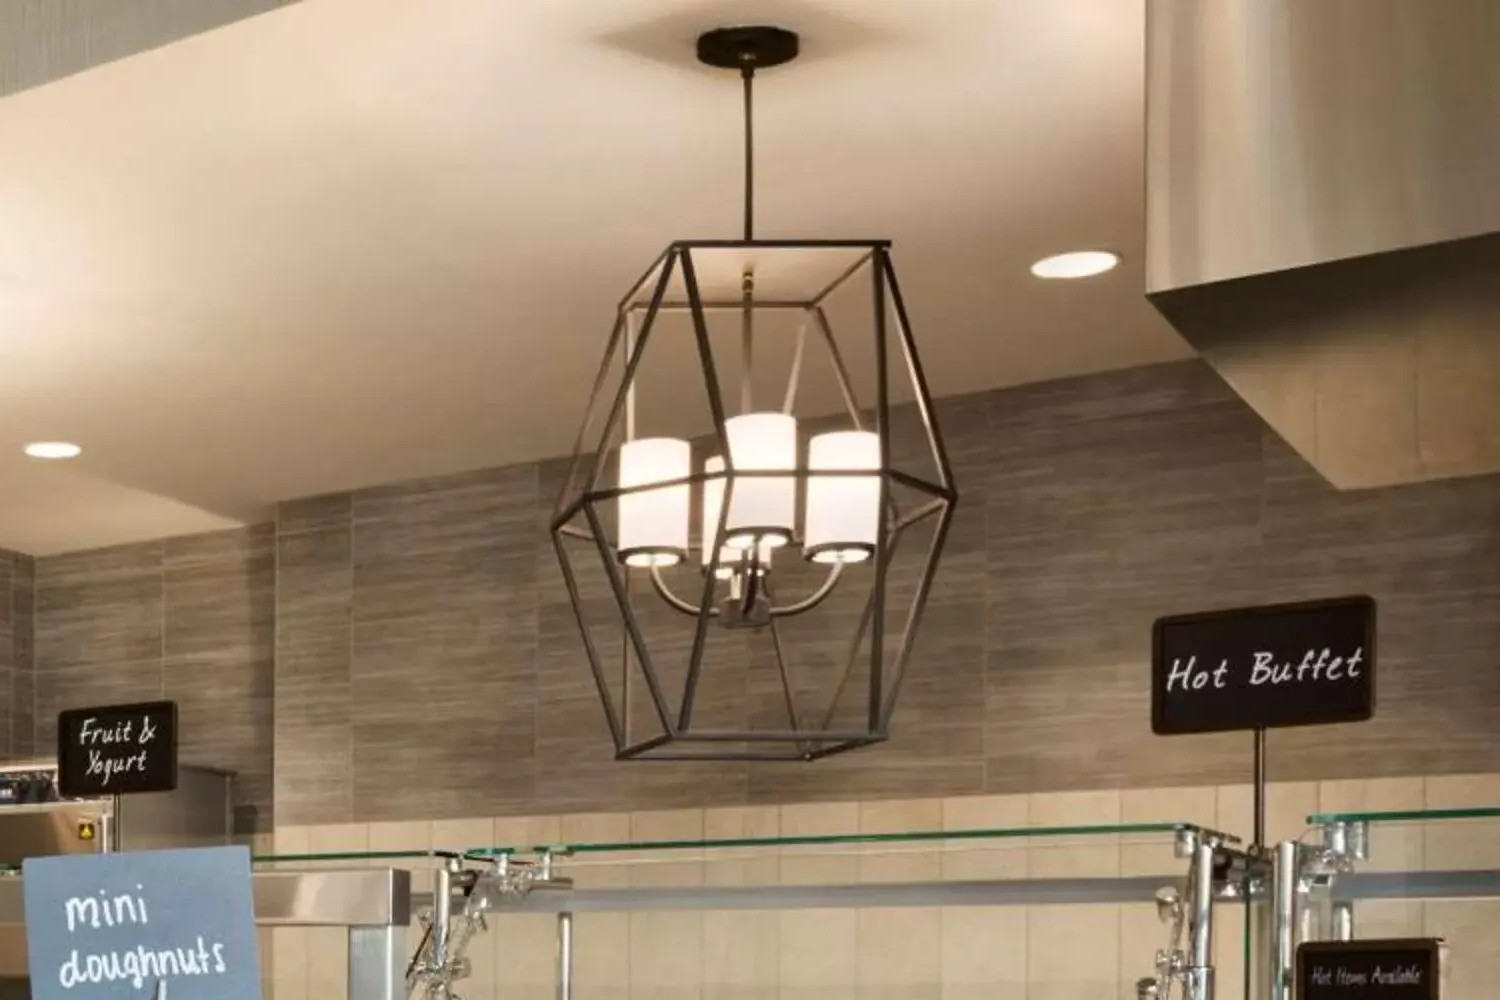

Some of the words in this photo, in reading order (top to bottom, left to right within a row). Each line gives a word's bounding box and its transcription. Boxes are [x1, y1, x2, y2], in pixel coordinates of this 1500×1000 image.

[1165, 655, 1229, 692] Hot
[1249, 646, 1363, 685] Buffet
[79, 717, 133, 745] Fruit
[138, 715, 156, 745] &
[85, 749, 148, 786] Yogurt
[65, 883, 149, 932] mini
[59, 935, 227, 990] doughnuts
